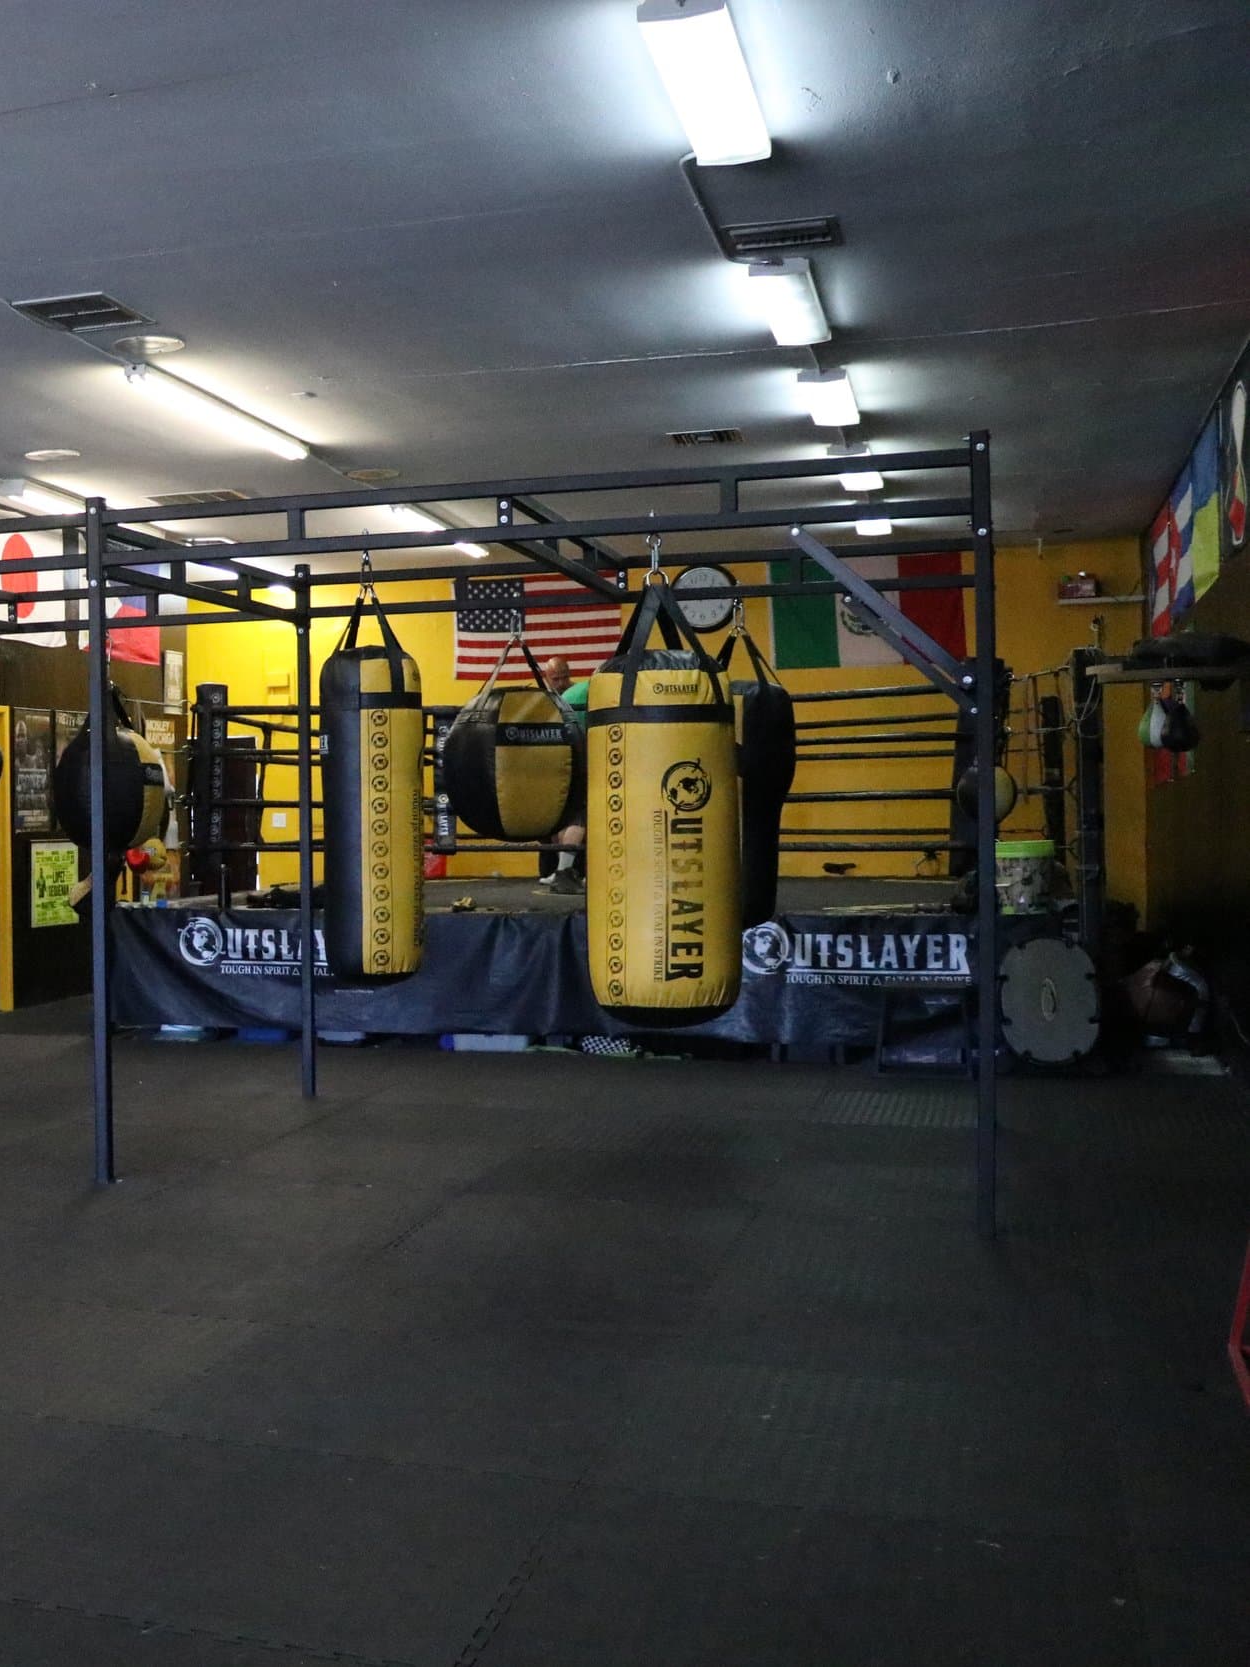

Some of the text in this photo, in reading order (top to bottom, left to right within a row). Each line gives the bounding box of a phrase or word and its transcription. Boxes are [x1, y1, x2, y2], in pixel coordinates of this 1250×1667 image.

[220, 964, 251, 975] TOUGH
[252, 965, 263, 975] IN
[264, 966, 290, 976] SPIRIT
[653, 948, 663, 983] STRIKE
[785, 973, 822, 984] TOUGH
[824, 974, 836, 985] IN
[838, 974, 870, 986] SPIRIT
